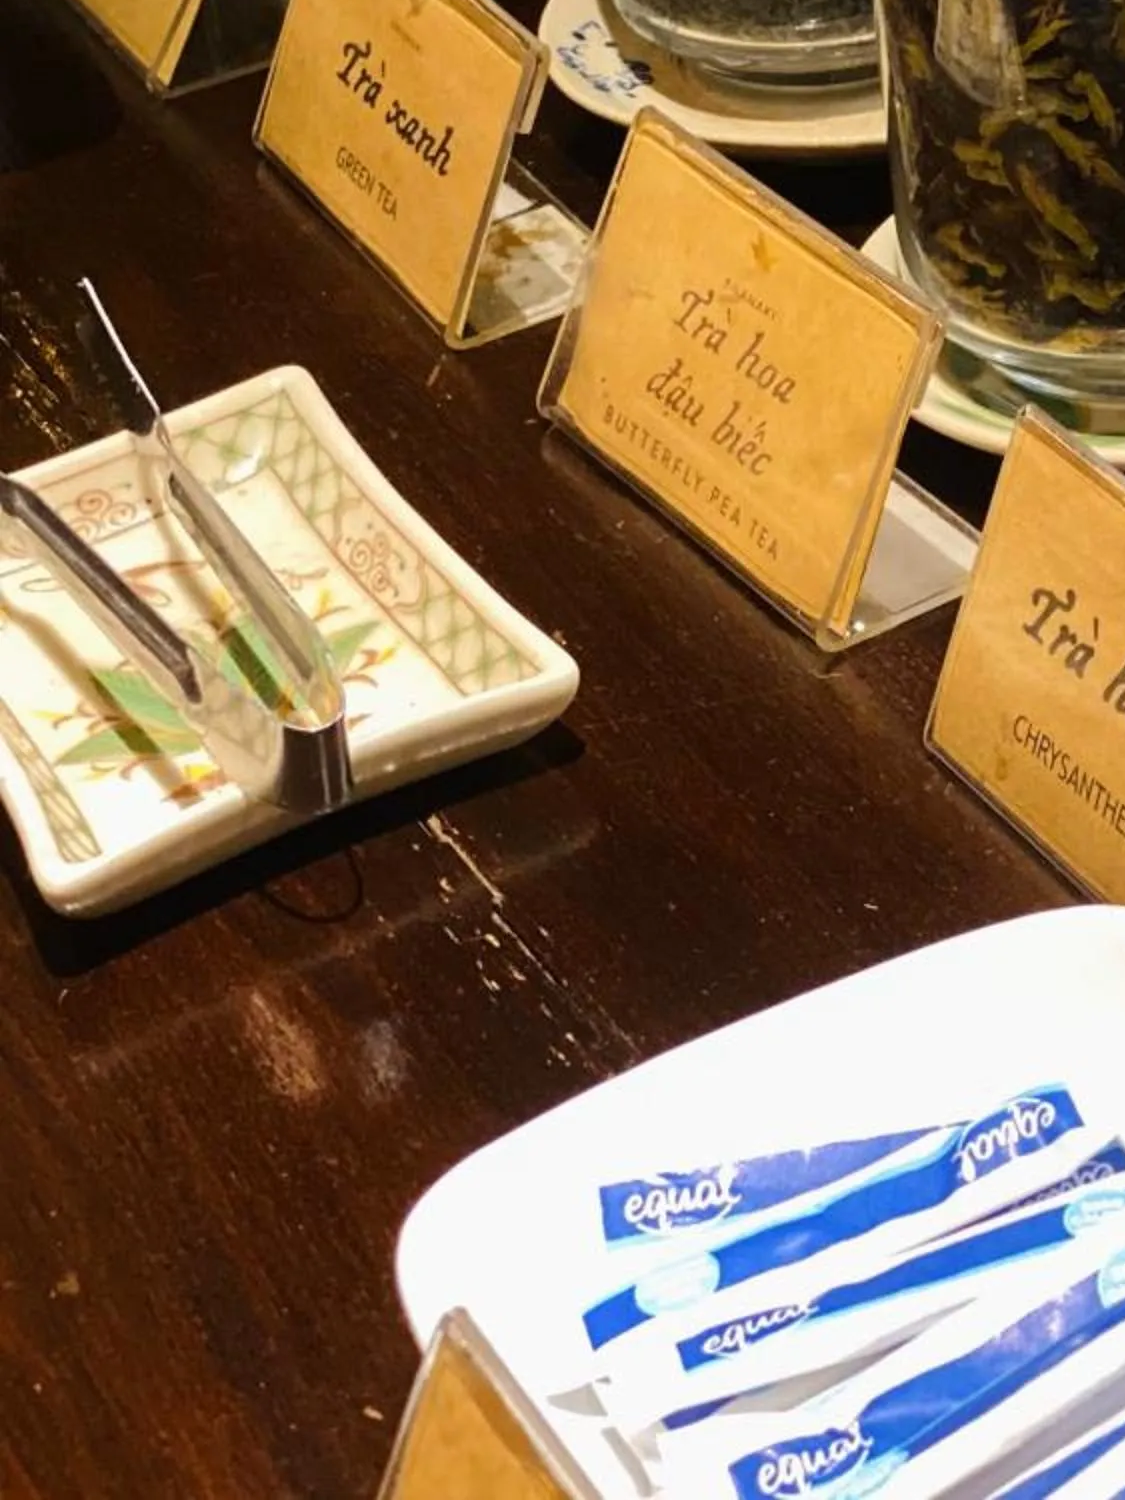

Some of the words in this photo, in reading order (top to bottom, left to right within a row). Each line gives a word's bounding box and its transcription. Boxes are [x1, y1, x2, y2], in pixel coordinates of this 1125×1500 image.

[336, 40, 386, 109] Trà
[384, 100, 454, 177] xanh
[336, 145, 376, 196] GREEN
[376, 181, 398, 221] TEA
[672, 288, 732, 355] Trà
[735, 331, 796, 404] hoa
[646, 357, 704, 427] đậu
[711, 400, 774, 476] biếc
[603, 404, 704, 494] BUTTERFLY
[709, 485, 741, 526] PEA
[749, 519, 778, 561] TEA
[1020, 586, 1101, 680] Trà
[951, 1100, 1056, 1182] equal
[623, 1160, 742, 1234] equal
[757, 1413, 874, 1495] equal
